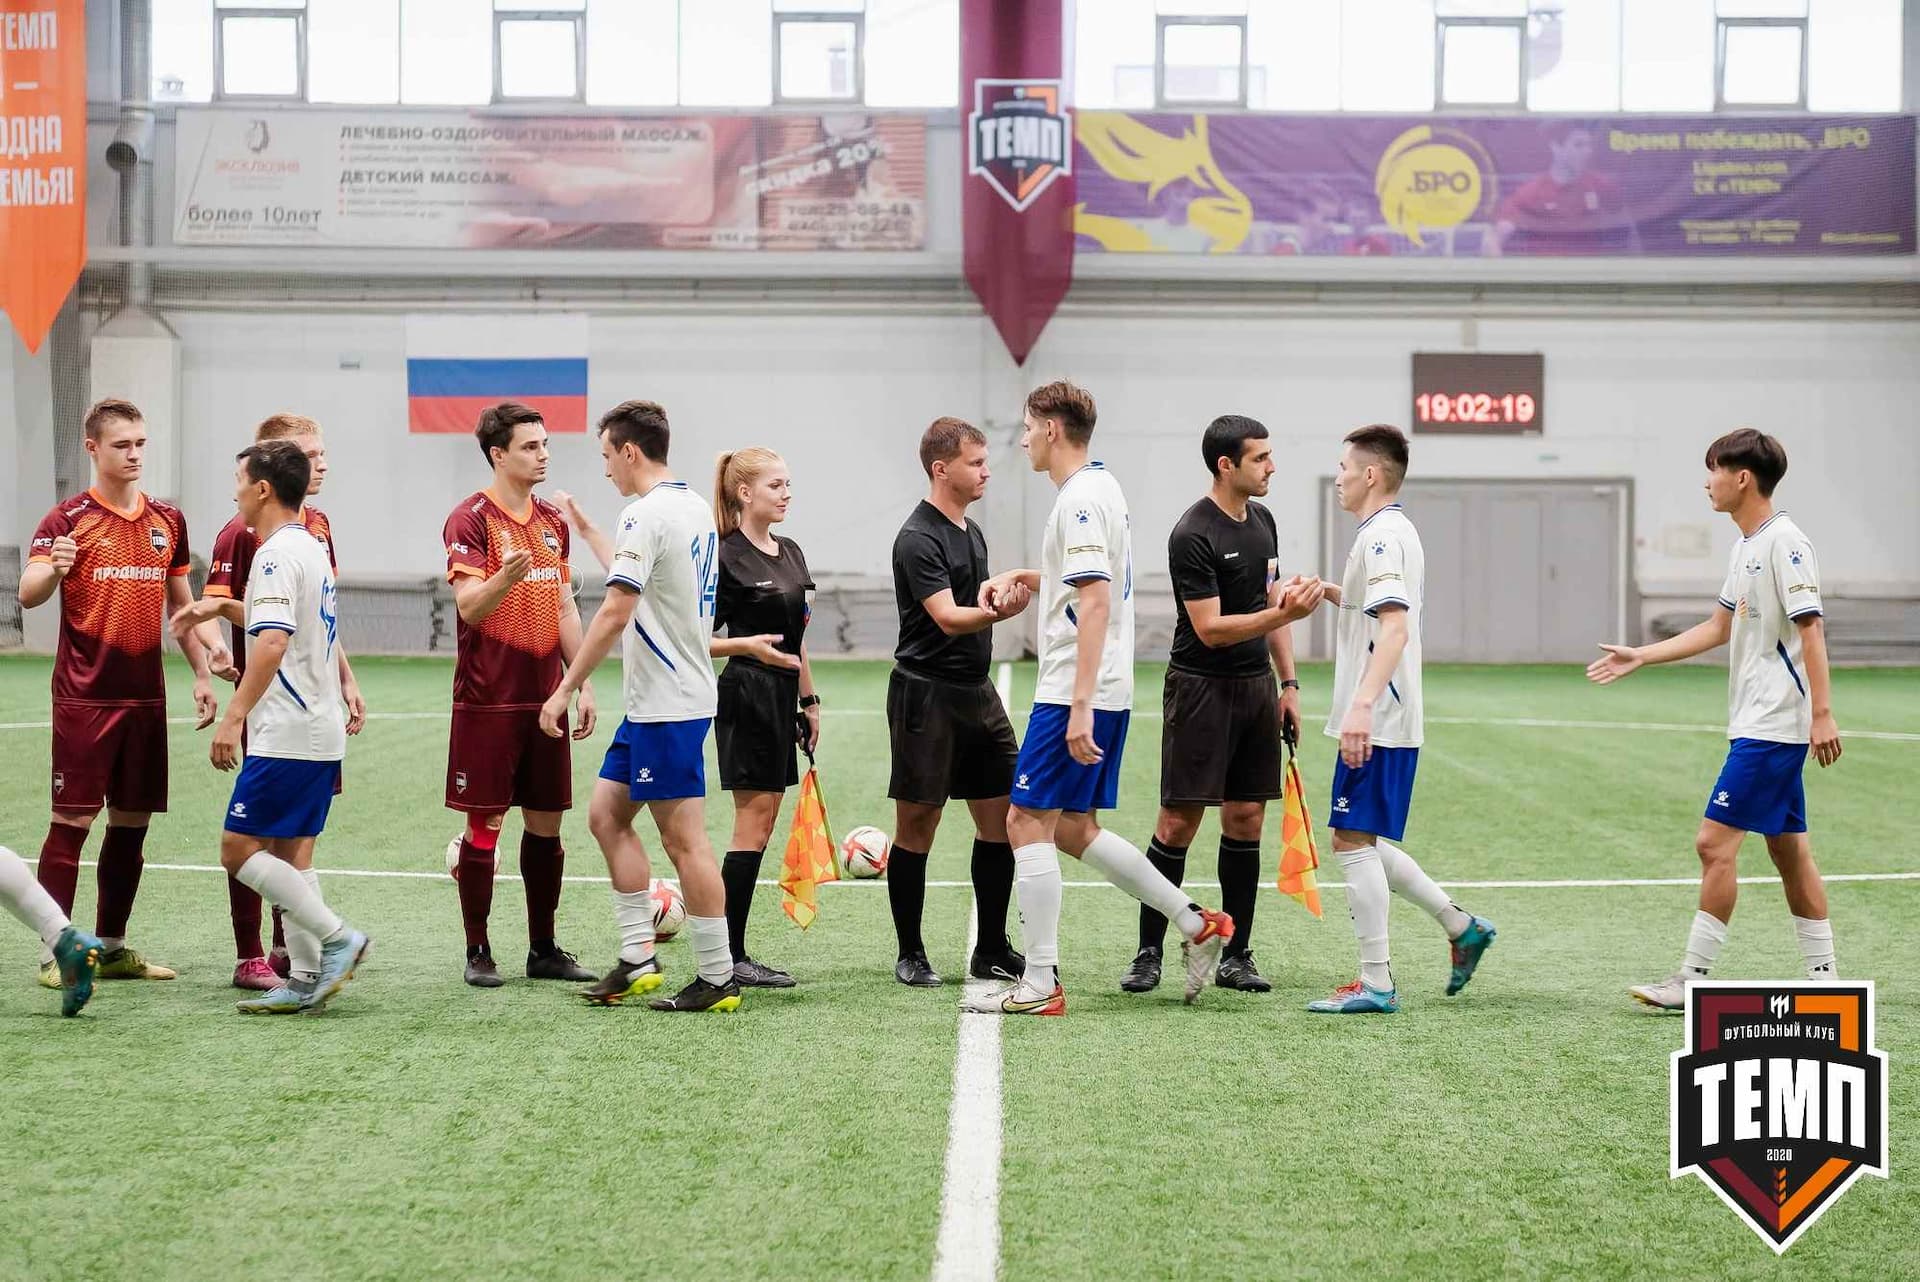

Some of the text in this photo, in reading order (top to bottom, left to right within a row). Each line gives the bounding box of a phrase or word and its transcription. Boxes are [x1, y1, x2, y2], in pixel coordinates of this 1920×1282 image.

[978, 116, 1062, 161] ТЕМП
[0, 166, 73, 206] ЕМЬЯ!
[340, 170, 424, 185] ДЕТСКИЙ
[188, 205, 253, 223] более
[1416, 393, 1535, 422] 19:02:19
[690, 532, 719, 618] 14
